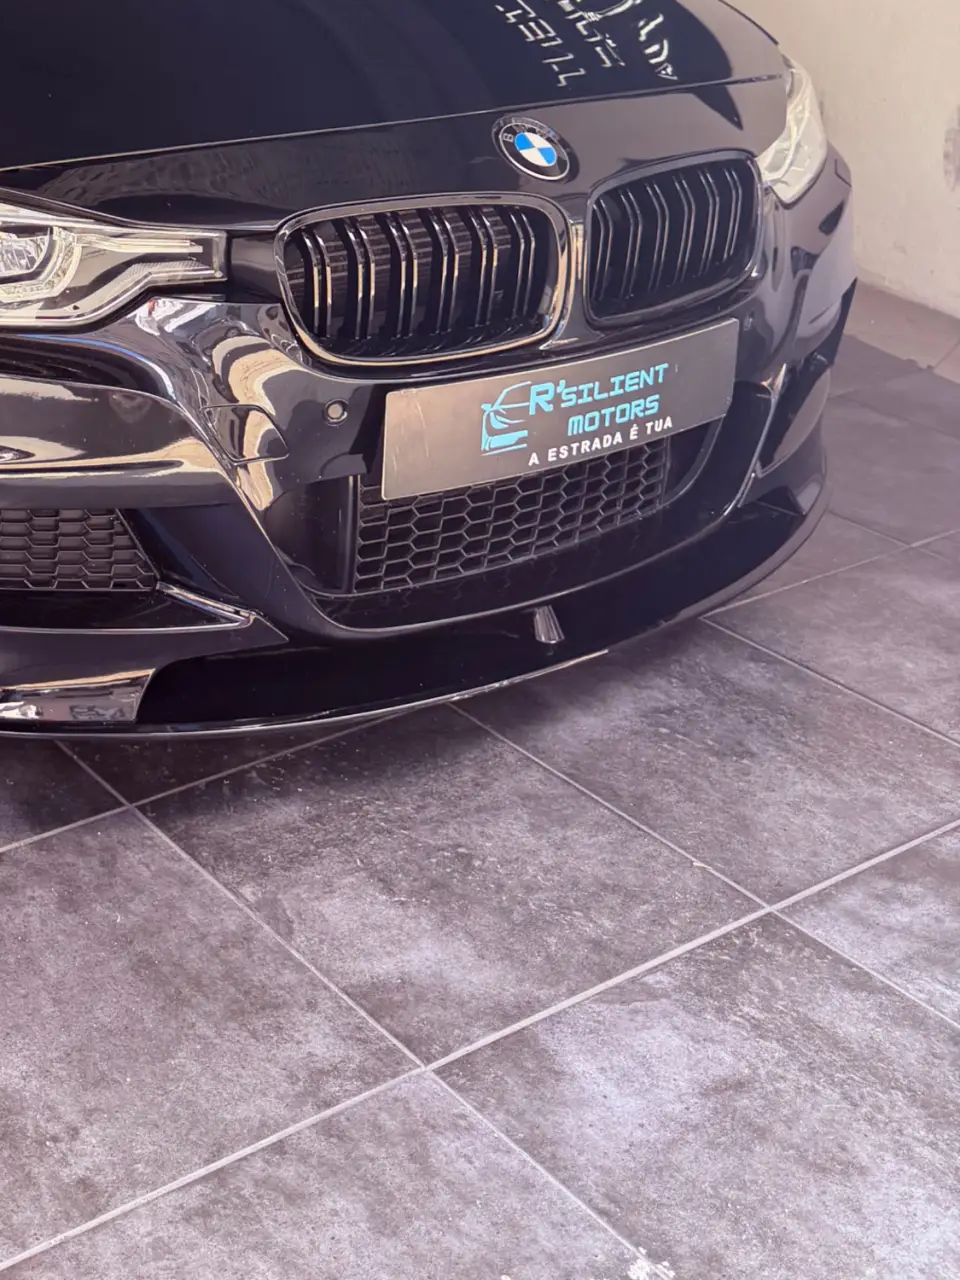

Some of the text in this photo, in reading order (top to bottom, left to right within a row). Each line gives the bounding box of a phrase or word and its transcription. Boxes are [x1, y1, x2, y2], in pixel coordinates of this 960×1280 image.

[529, 363, 669, 416] R'SILIENT
[568, 394, 660, 436] MOTORS
[528, 416, 673, 466] A ESTRADA É TUA
